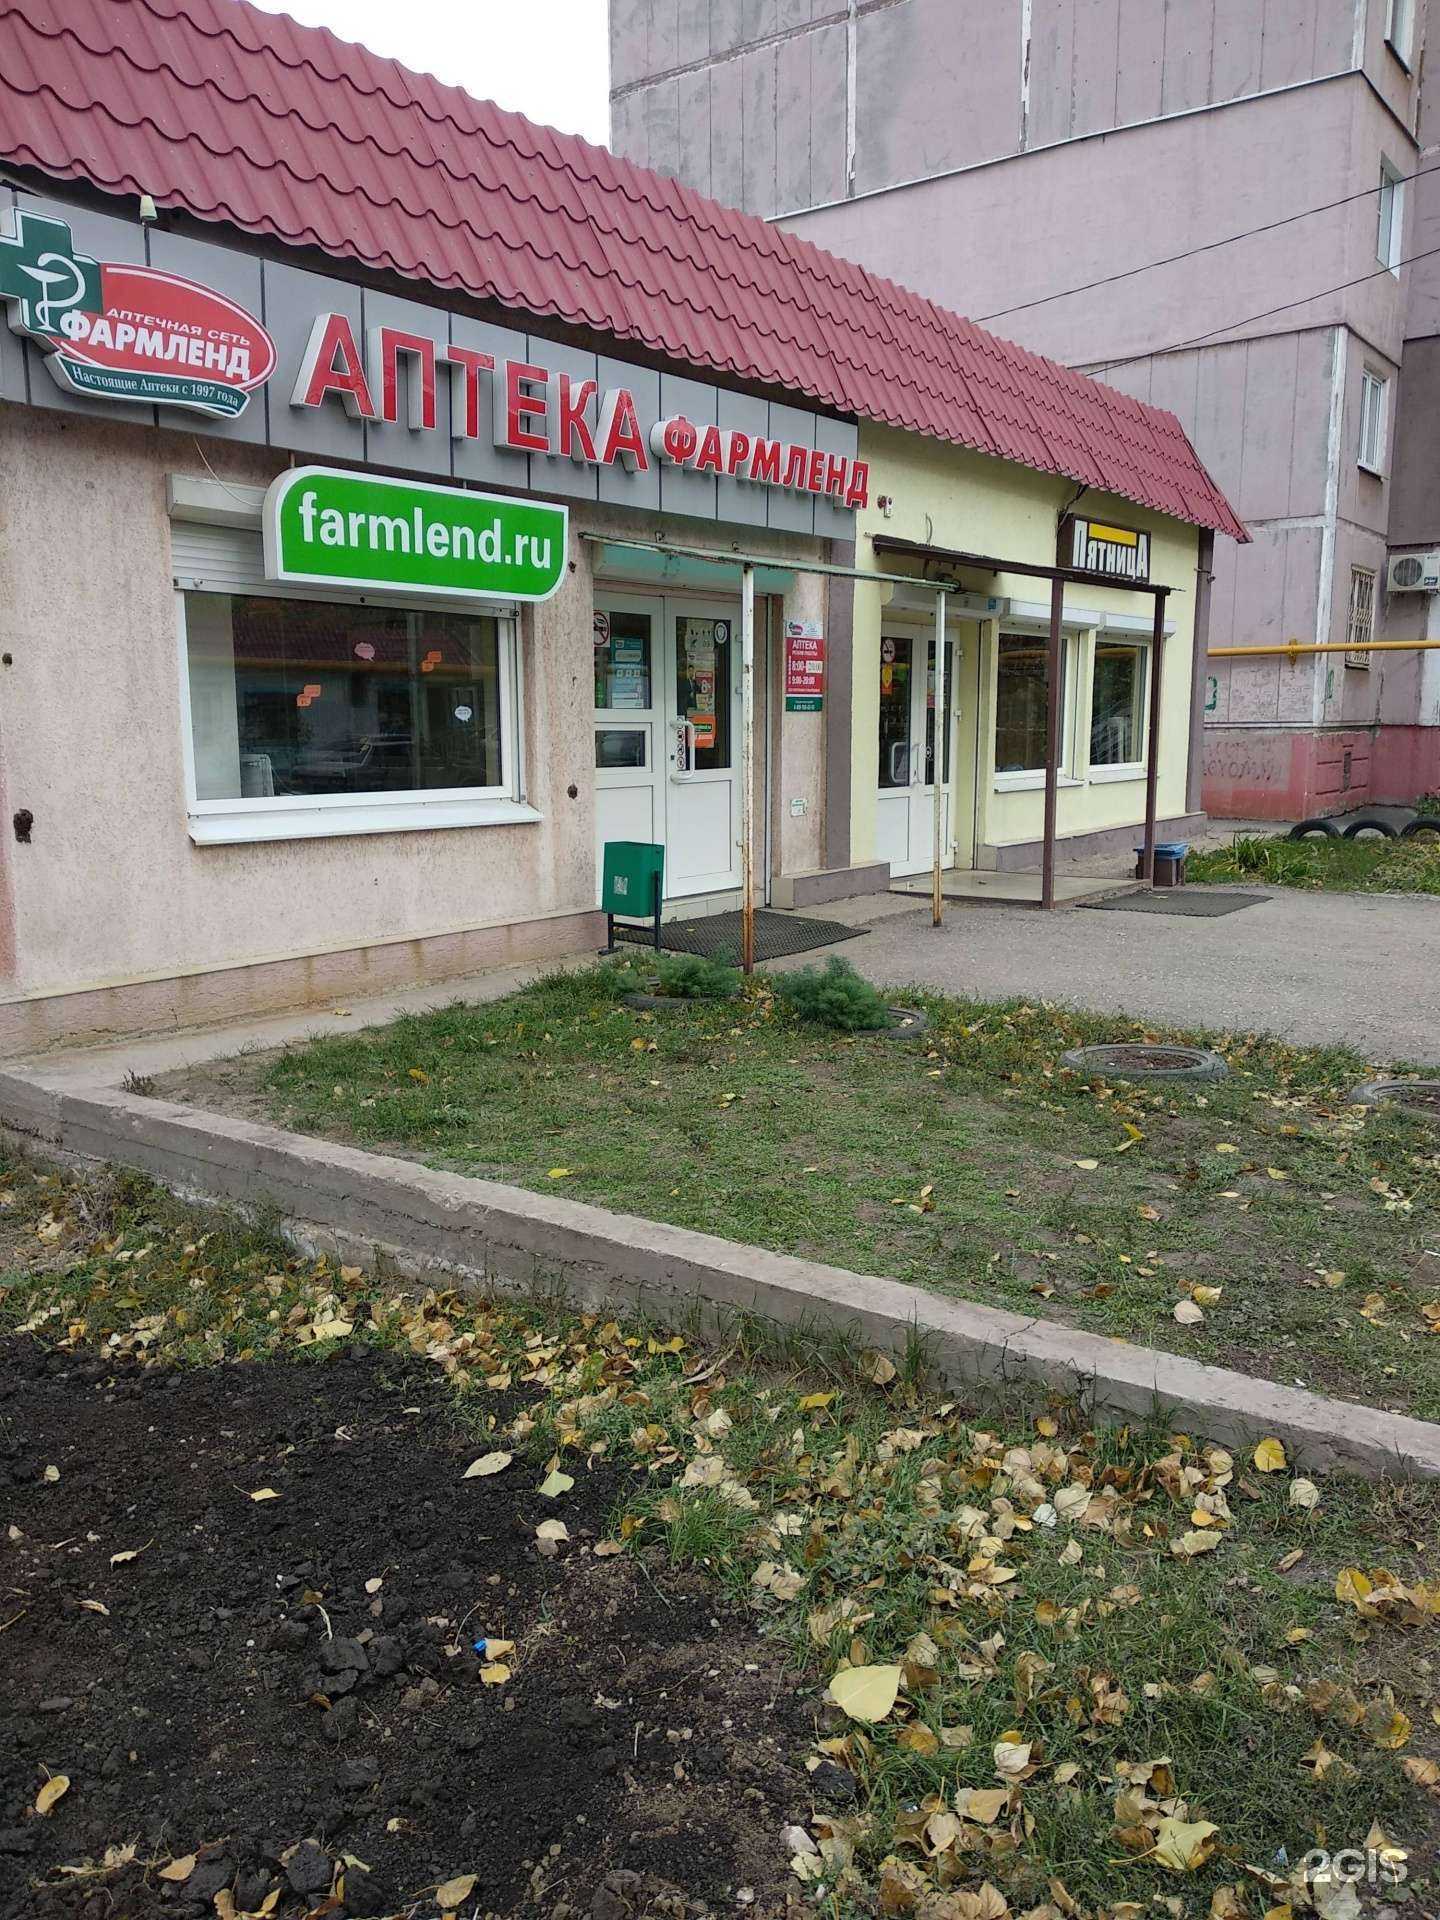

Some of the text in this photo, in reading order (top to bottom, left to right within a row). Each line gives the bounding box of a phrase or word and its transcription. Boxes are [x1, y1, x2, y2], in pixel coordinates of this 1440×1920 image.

[59, 309, 250, 382] ФАРМЛЕНД
[106, 307, 250, 346] АПТЕЧНАЯ СЕТЬ
[71, 365, 239, 408] Настоящие Аптеки с 1997 года
[297, 312, 870, 510] АПТЕКА ФАРМЛЕНД
[298, 491, 551, 570] farmlend.ru
[791, 639, 818, 651] АПТЕКА
